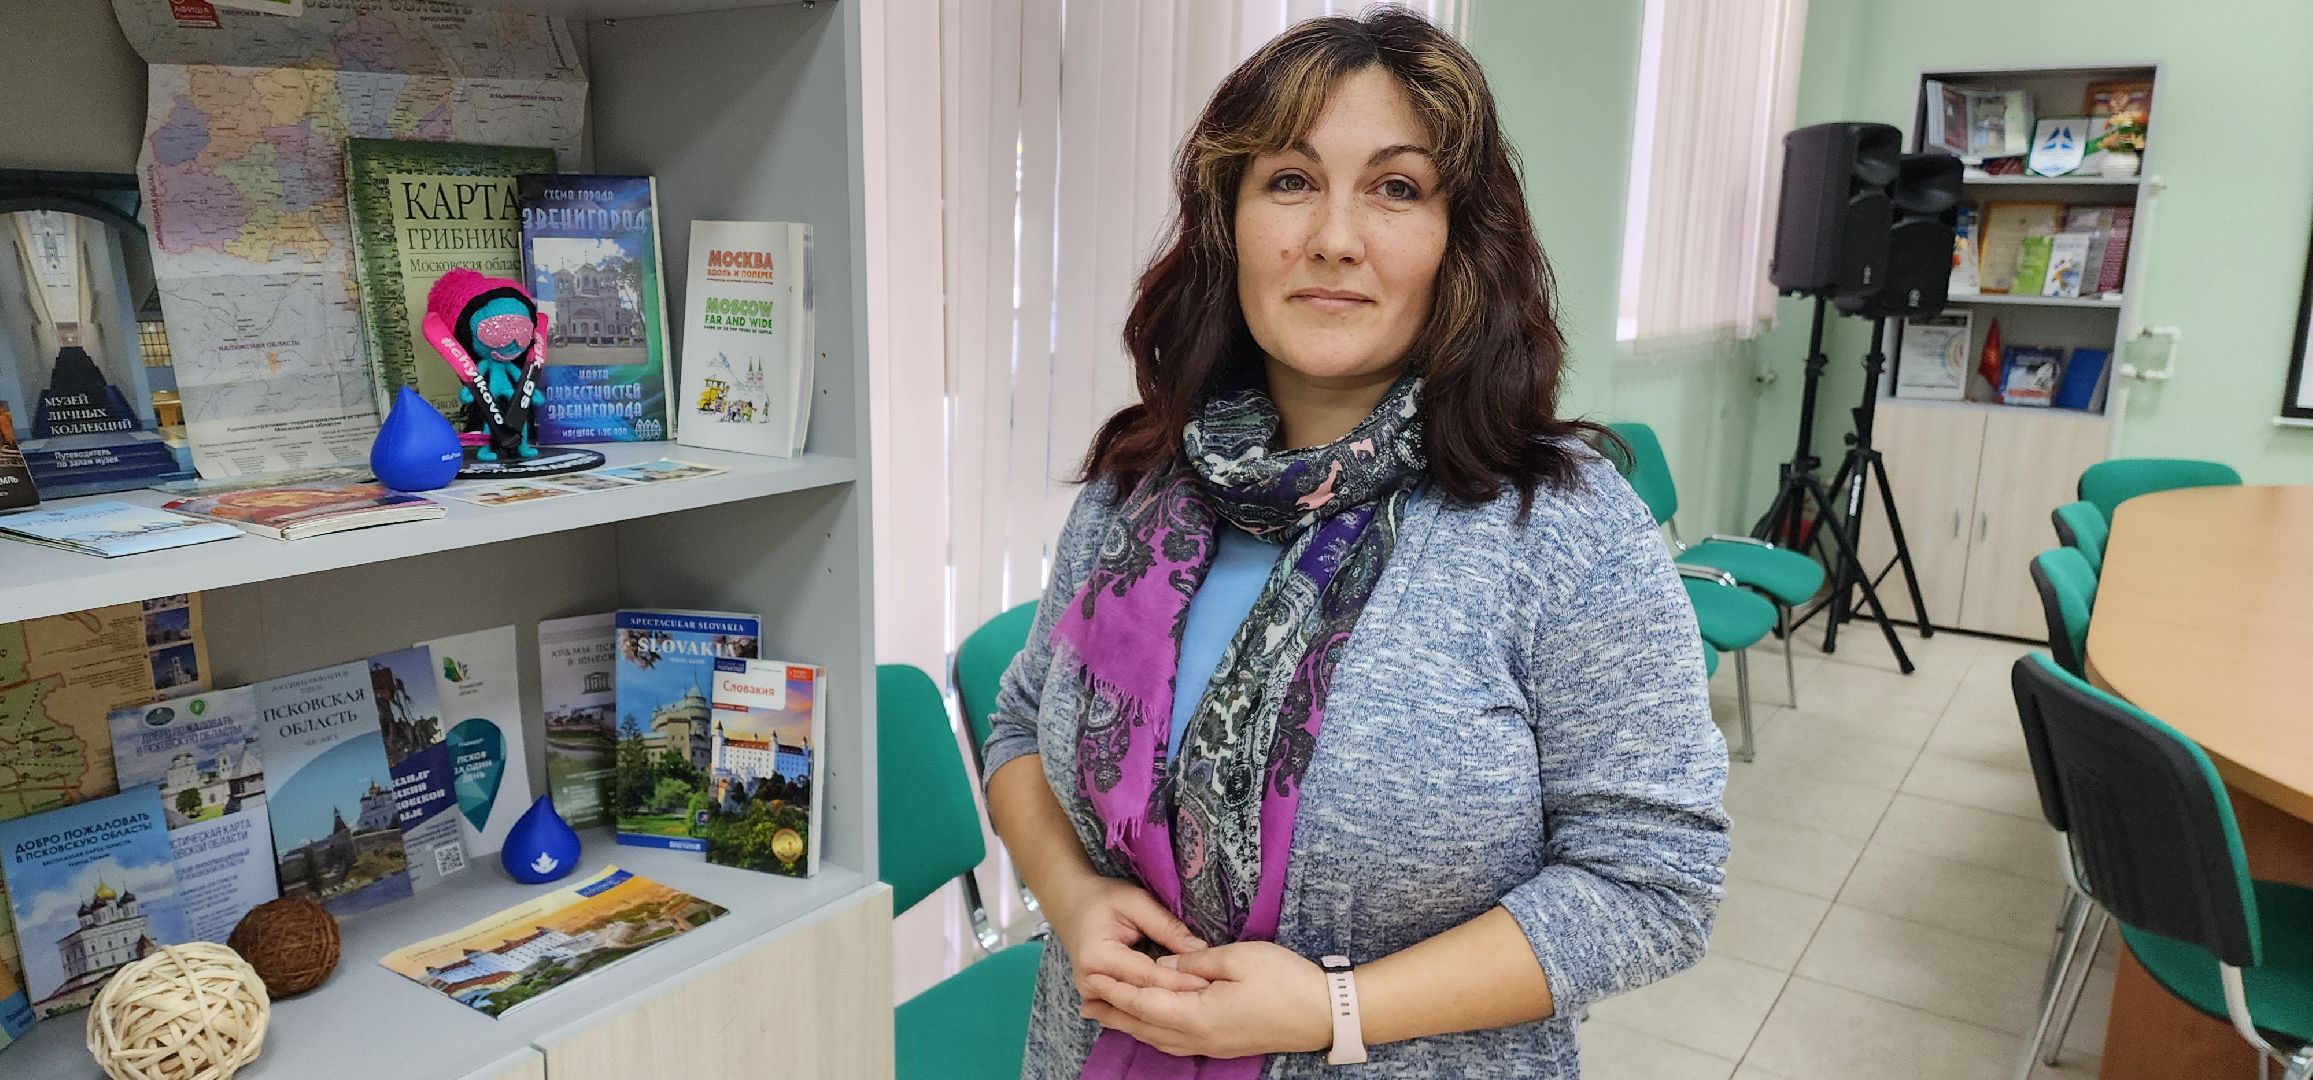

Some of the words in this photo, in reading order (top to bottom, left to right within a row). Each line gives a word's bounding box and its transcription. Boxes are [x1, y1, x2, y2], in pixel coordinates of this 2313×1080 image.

[401, 181, 521, 220] КАРТА
[577, 190, 615, 202] ГОРОДА
[521, 207, 648, 233] ЗВЕНИГОРОД
[406, 228, 519, 250] ГРИБНИК
[410, 258, 482, 273] Московская
[707, 249, 774, 270] МОСКВА
[707, 269, 731, 277] ВДОЛЬ
[705, 297, 774, 318] MOSCOW
[704, 314, 722, 325] FAR
[725, 316, 746, 327] AND
[749, 317, 773, 329] WIDE
[441, 337, 504, 425] #chylkovo
[44, 393, 89, 407] МУЗЕЙ
[546, 382, 641, 401] ОКРЕСТНОСТЕЙ
[48, 408, 108, 421] ЛИЧНЫХ
[548, 402, 642, 419] ЗВЕНИГОРОДА
[51, 418, 132, 435] КОЛЛЕКЦИЙ
[54, 449, 112, 461] Путеводитель
[630, 618, 696, 630] SPECTACULAR
[698, 622, 744, 632] SLOVAKIA
[637, 637, 737, 658] SLOVAKIA
[722, 680, 775, 697] Словакия
[263, 689, 365, 722] ПСКОВСКАЯ
[279, 710, 357, 738] ОБЛАСТЬ
[457, 751, 487, 764] ПСКОВ
[15, 833, 60, 855] ДОБРО
[64, 812, 150, 842] ПОЖАЛОВАТЬ
[16, 855, 22, 863] В
[26, 836, 98, 861] ПСКОВСКУЮ
